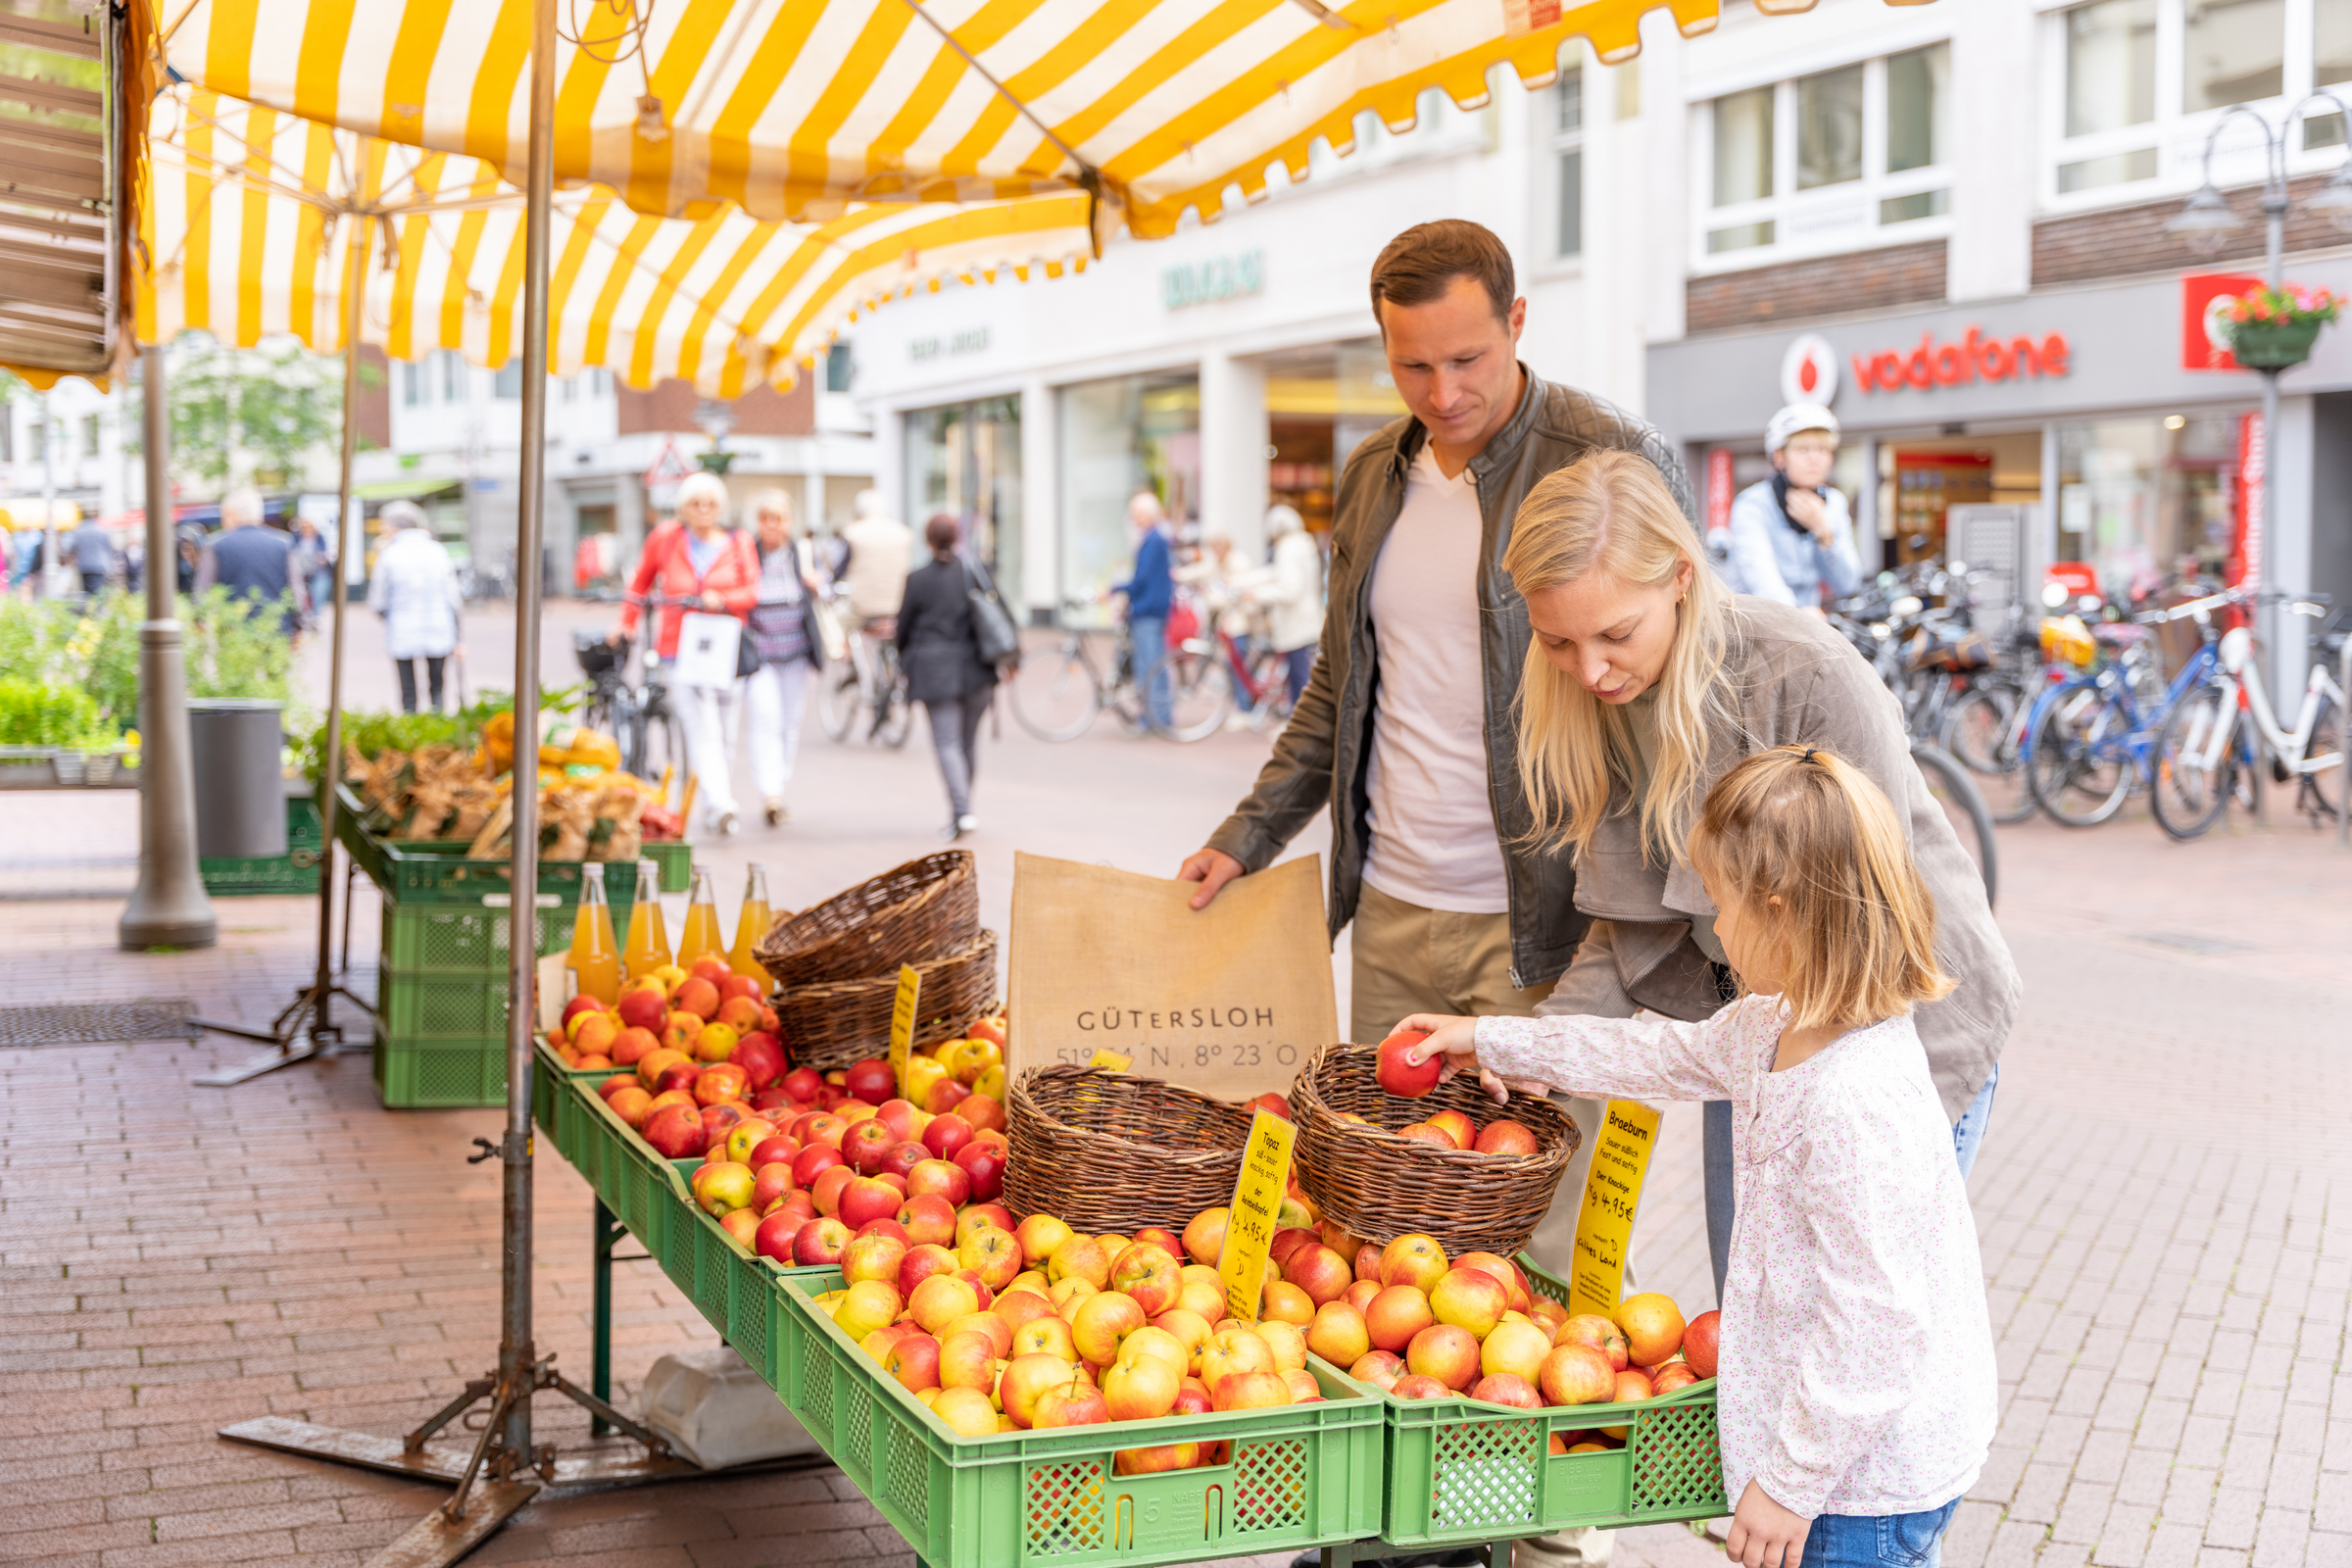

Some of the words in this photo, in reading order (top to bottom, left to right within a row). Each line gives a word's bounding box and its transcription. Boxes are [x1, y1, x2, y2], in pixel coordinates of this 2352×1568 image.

[1850, 323, 2070, 394] vodafone
[1077, 1006, 1273, 1030] GÜTERSLOH
[1608, 1110, 1648, 1142] Braeburn
[1263, 1131, 1280, 1151] Topaz
[1605, 1137, 1621, 1150] Sauer
[1599, 1147, 1611, 1160] Fest
[1611, 1155, 1622, 1165] und
[1622, 1160, 1638, 1176] saftig
[1595, 1169, 1607, 1182] Der
[1607, 1175, 1630, 1195] Knackige
[1598, 1250, 1617, 1270] Land
[1172, 1490, 1203, 1504] NAPF
[1144, 1497, 1161, 1524] 5
